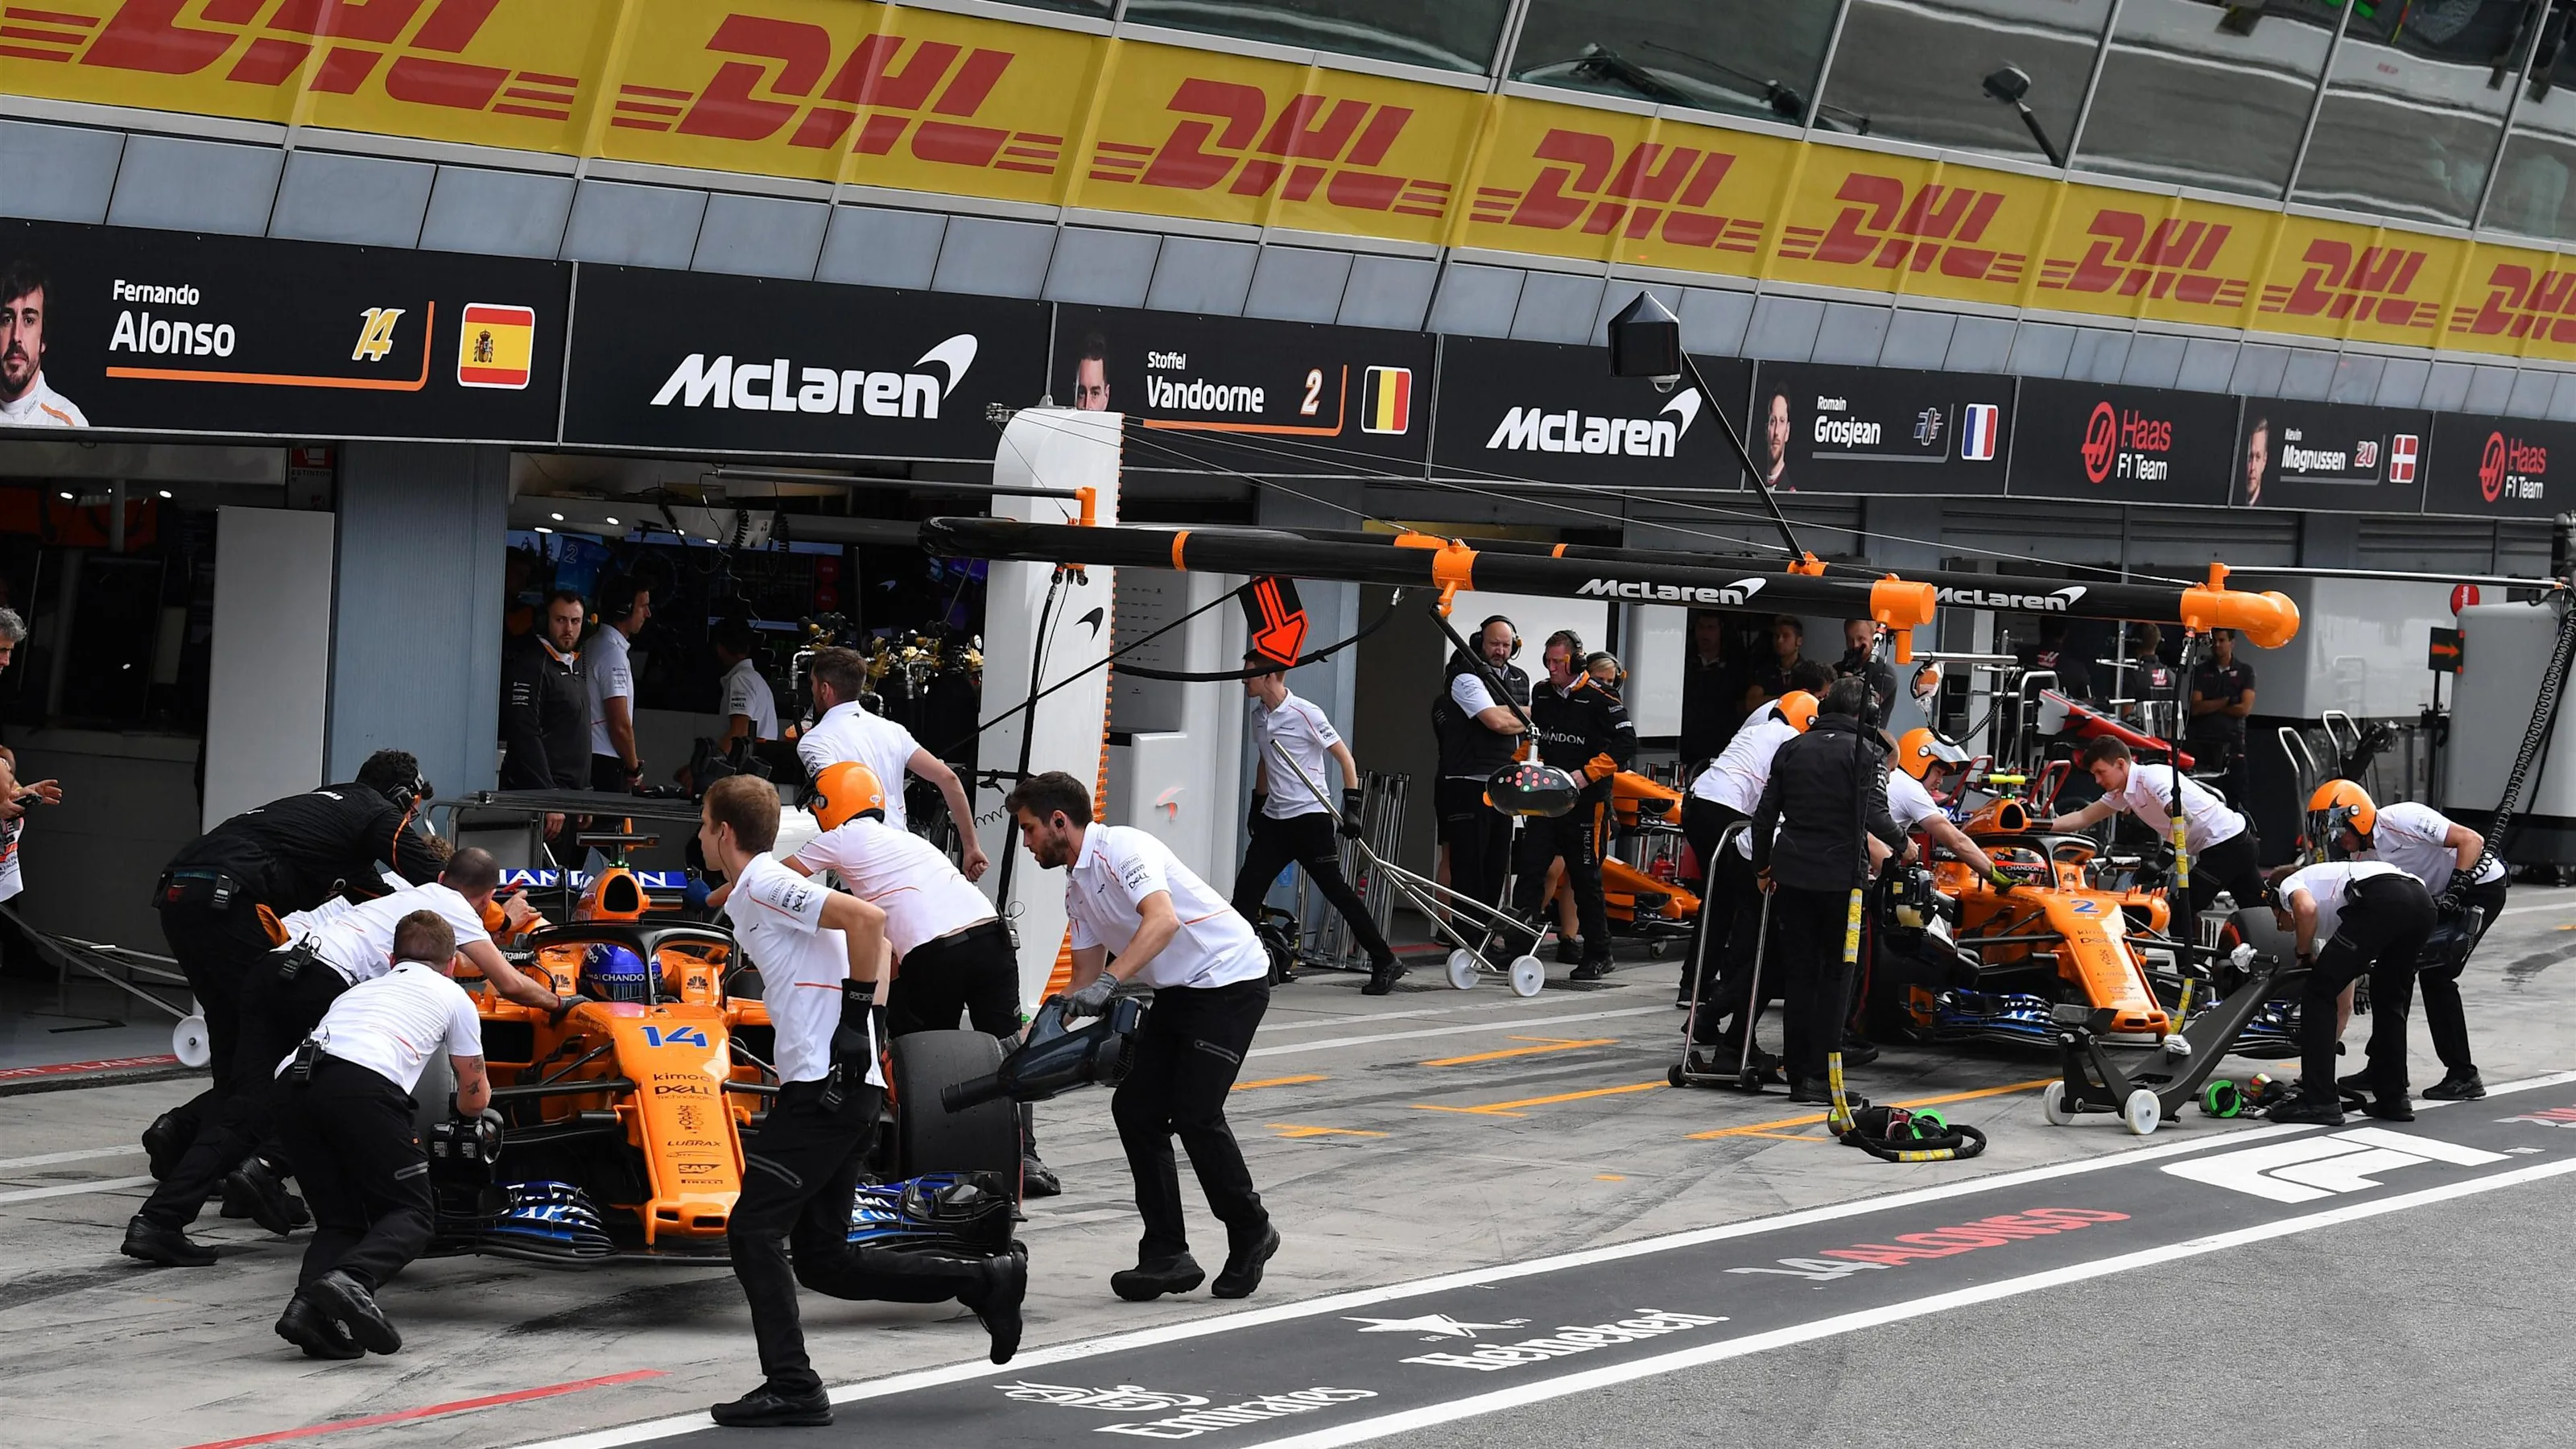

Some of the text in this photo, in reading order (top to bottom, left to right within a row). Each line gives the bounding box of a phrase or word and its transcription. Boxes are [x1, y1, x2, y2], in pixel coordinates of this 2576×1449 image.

[79, 0, 511, 110] DHL
[675, 14, 1015, 167] DHL
[1139, 77, 1414, 212] DHL
[1509, 129, 1736, 248] DHL
[1813, 172, 2005, 280] DHL
[2066, 209, 2232, 304] DHL
[113, 279, 200, 306] Fernando
[2285, 239, 2427, 325] DHL
[109, 307, 407, 362] Alonso 14
[1147, 351, 1187, 370] Stoffel
[650, 353, 941, 419] McLaren
[1146, 369, 1323, 415] Vandoorne 2
[1817, 395, 1847, 411] Romain
[1485, 407, 1675, 457] McLaren
[1814, 415, 1881, 448] Grosjean
[2121, 411, 2172, 452] Haas
[2284, 427, 2303, 442] Kevin
[2116, 453, 2168, 481] F1 Team
[2281, 440, 2379, 473] Magnussen 20
[2509, 441, 2546, 473] Haas
[2505, 474, 2544, 499] F1 Team
[564, 543, 579, 564] 2
[1575, 578, 1744, 605] McLaren
[1541, 728, 1585, 745] HANDON
[1120, 856, 1139, 871] Hilton
[1129, 872, 1150, 890] DELL
[792, 889, 808, 912] DELL
[2070, 898, 2103, 914] 2
[603, 972, 646, 982] CHANDO
[640, 1026, 708, 1047] 14
[653, 1072, 712, 1082] kimoa
[654, 1084, 715, 1095] DELL
[679, 1163, 713, 1174] SAP
[1818, 1208, 2132, 1266] ALONSO
[1397, 1308, 1731, 1372] Heineken
[1092, 1386, 1379, 1440] Emirates
